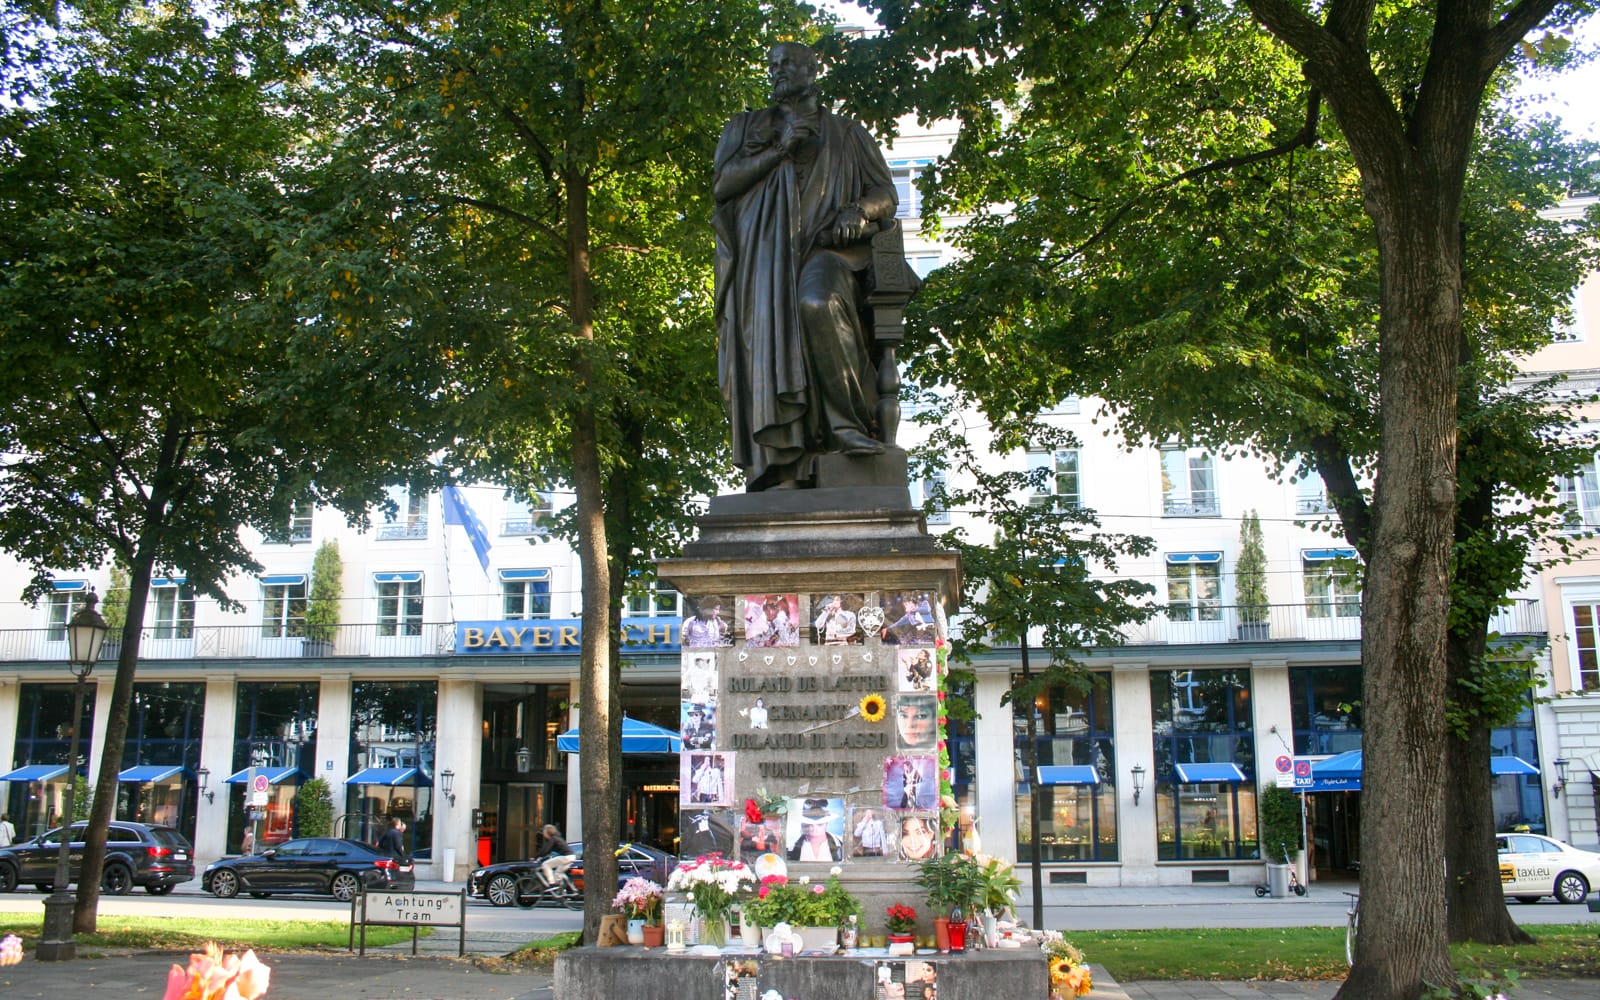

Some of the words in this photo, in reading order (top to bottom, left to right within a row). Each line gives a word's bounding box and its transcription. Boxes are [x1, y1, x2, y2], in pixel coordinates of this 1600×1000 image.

[728, 676, 792, 693] ROLAND
[797, 676, 818, 692] DE
[823, 675, 888, 692] LATTRE
[731, 733, 805, 750] ORLANDO
[810, 733, 827, 749] DI
[831, 732, 888, 749] LASSO
[759, 761, 860, 778] TONDICHTER
[1517, 866, 1550, 878] taxi.eu
[385, 896, 443, 910] Achtung
[397, 909, 431, 921] Tram
